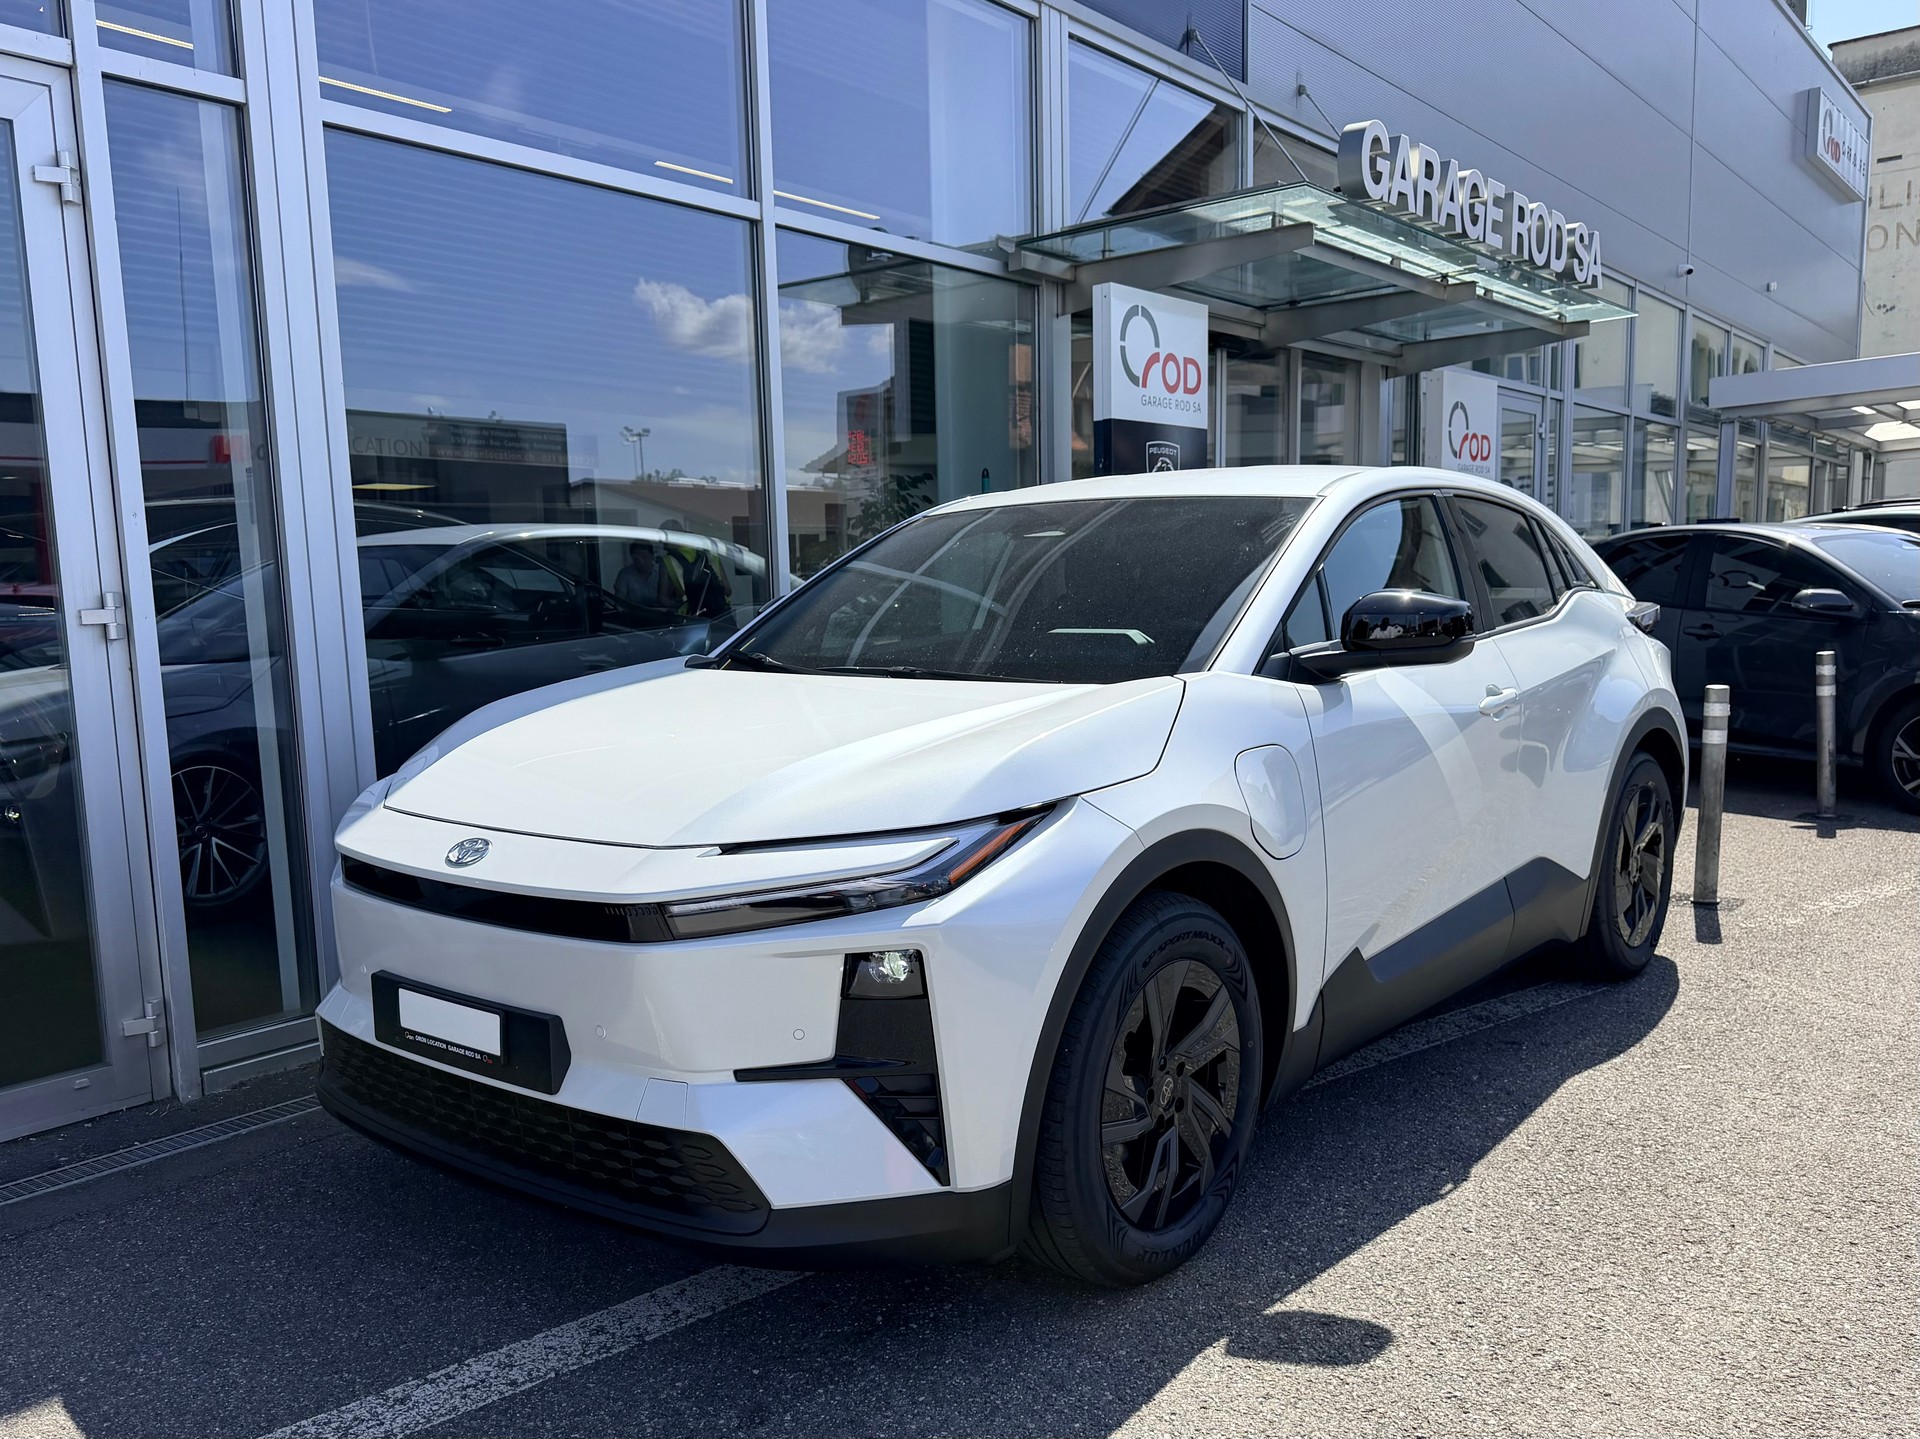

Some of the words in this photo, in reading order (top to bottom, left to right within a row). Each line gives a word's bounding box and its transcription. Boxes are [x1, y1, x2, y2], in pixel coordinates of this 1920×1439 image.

[1357, 119, 1506, 250] GARAGE
[1511, 190, 1568, 273] ROD
[1573, 221, 1603, 290] SA
[1140, 394, 1173, 410] GARAGE
[1175, 398, 1191, 413] ROD
[1192, 401, 1202, 414] SA
[1148, 446, 1178, 456] PEUGEOT
[1458, 463, 1475, 473] GARAGE
[427, 1038, 447, 1049] LOCATION
[447, 1044, 465, 1055] GARAGE
